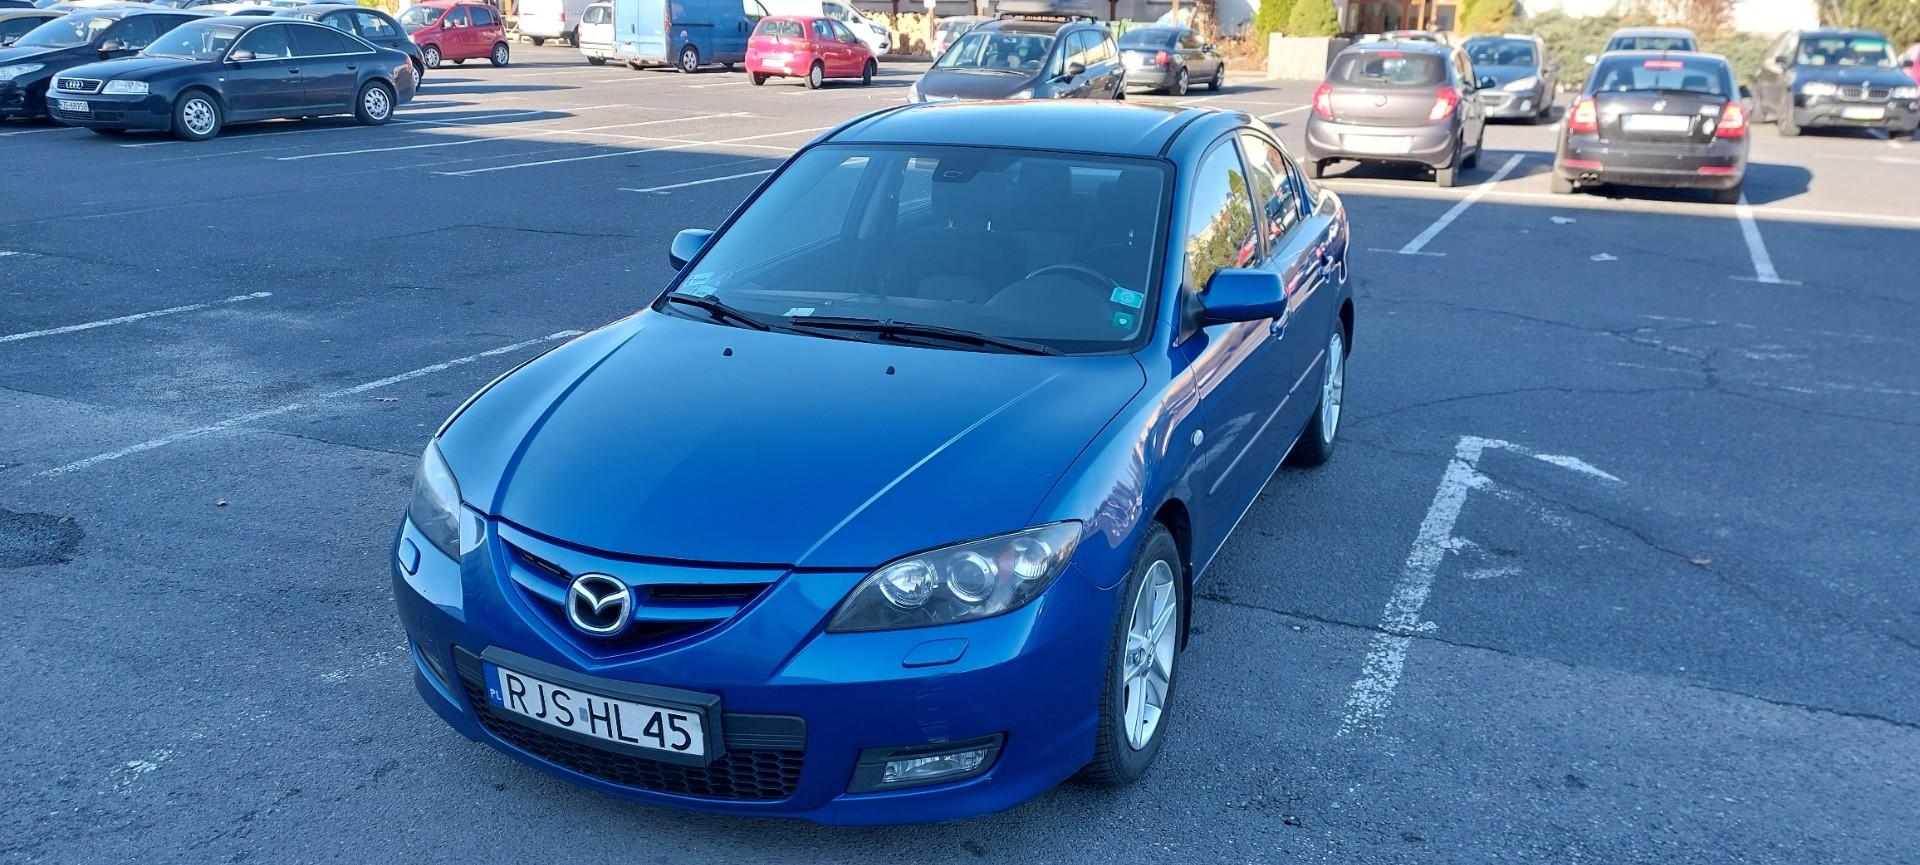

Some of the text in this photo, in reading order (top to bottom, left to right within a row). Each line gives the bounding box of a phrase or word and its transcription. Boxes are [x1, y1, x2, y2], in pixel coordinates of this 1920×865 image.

[489, 688, 502, 701] PL
[506, 673, 692, 751] RJS HL45
